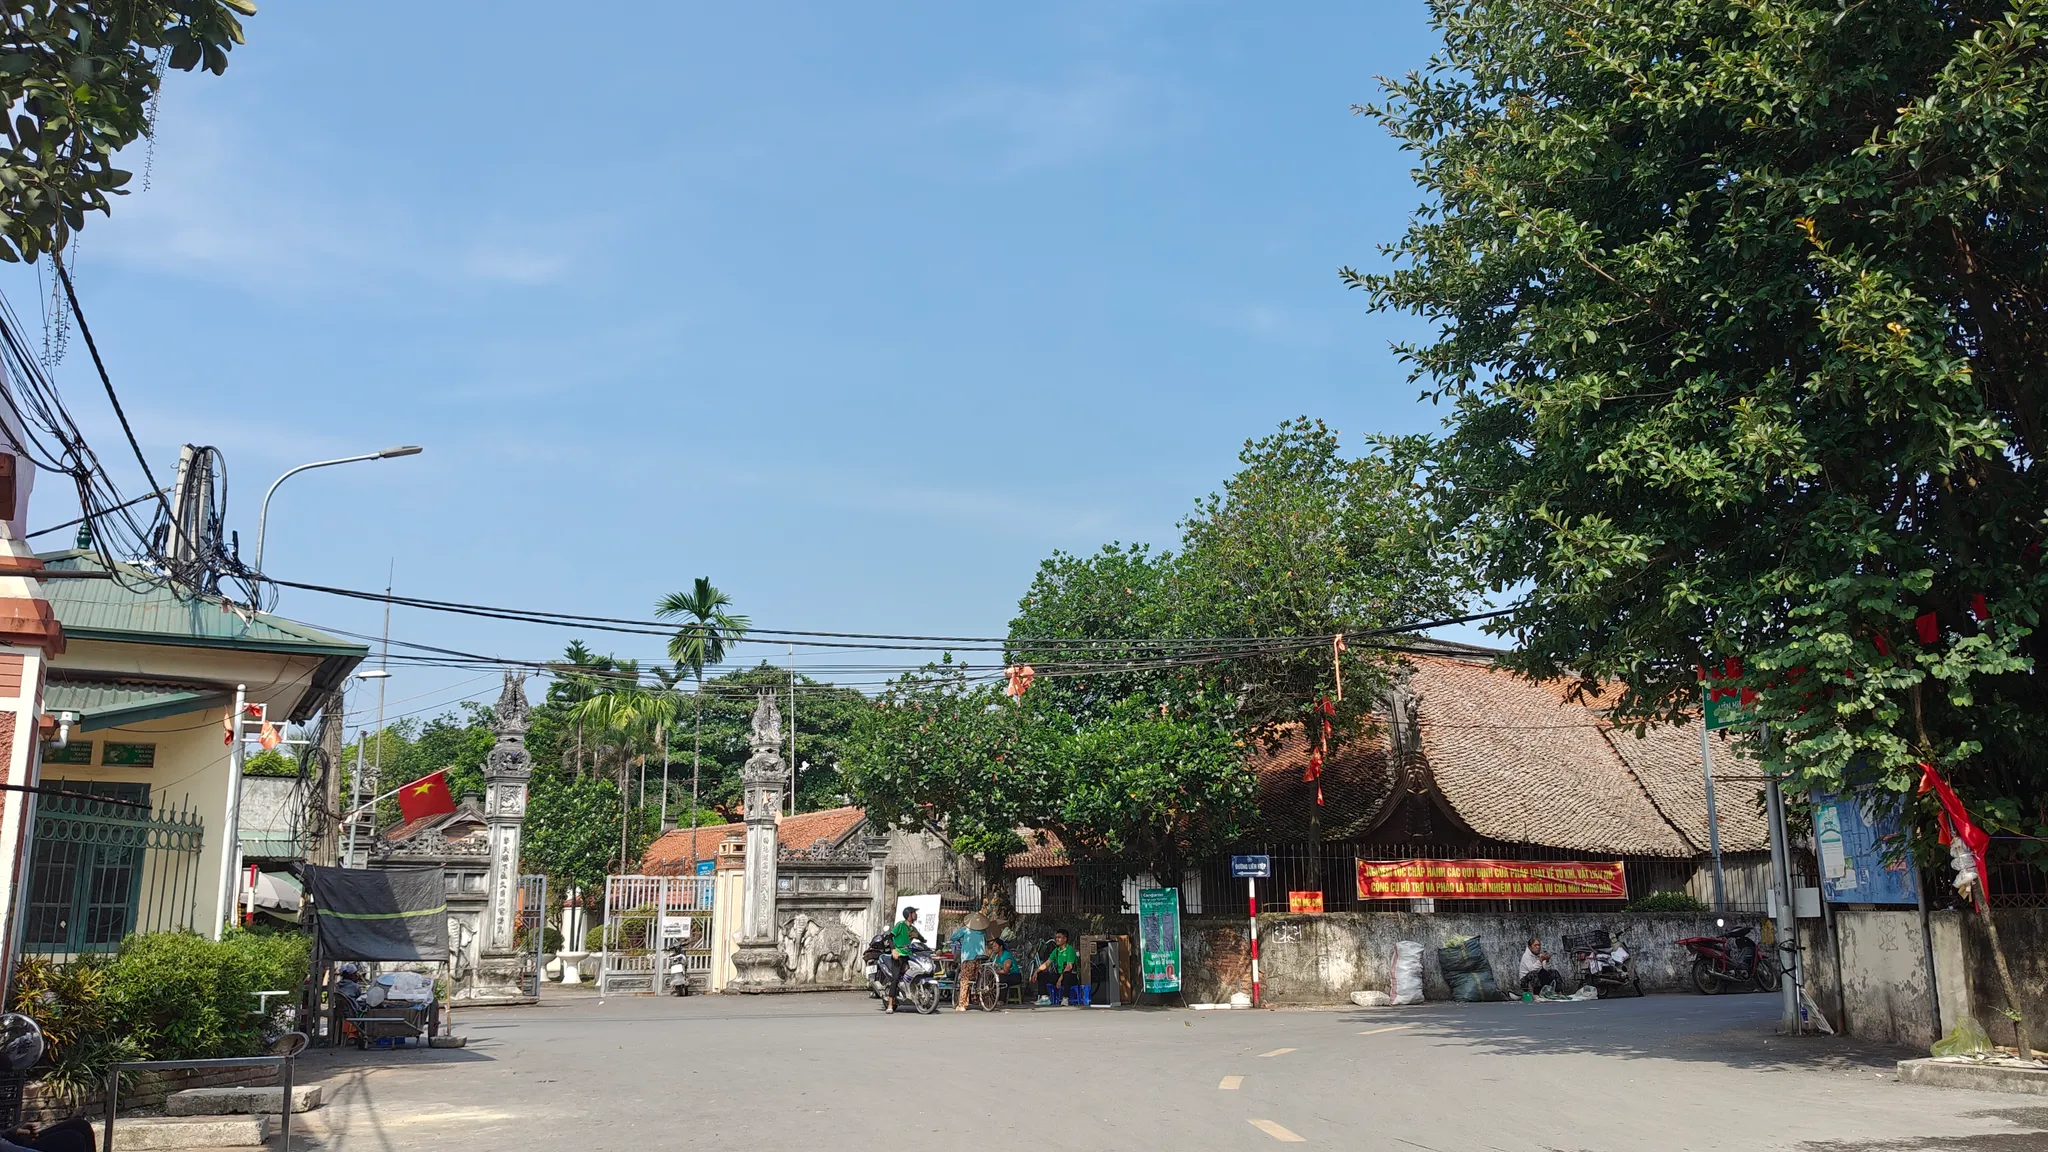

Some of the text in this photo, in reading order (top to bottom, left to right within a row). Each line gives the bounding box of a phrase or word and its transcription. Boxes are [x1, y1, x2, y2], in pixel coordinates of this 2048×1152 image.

[1394, 865, 1406, 878] TÚC
[1408, 864, 1425, 878] CHẤP
[1427, 865, 1445, 878] HÀNH
[1446, 864, 1460, 878] CÁC
[1462, 866, 1475, 878] QUY
[1476, 866, 1493, 880] ĐỊNH
[1494, 864, 1508, 878] CỦA
[1510, 866, 1528, 878] PHÁP
[1371, 880, 1389, 893] CÔNG
[1390, 881, 1399, 894] CỤ
[1401, 878, 1410, 893] HỖ
[1411, 881, 1425, 894] TRỢ
[1425, 880, 1435, 893] VÀ
[1436, 880, 1454, 893] PHÁO
[1456, 880, 1465, 893] LÀ
[1465, 880, 1487, 893] TRÁCH
[1488, 881, 1511, 895] NHIỆM
[1512, 880, 1523, 893] VÀ
[1523, 881, 1544, 893] NGHĨA
[1544, 883, 1554, 895] VỤ
[1554, 881, 1567, 893] CỦA
[1581, 881, 1598, 894] CÔNG
[1598, 882, 1612, 894] DÂN
